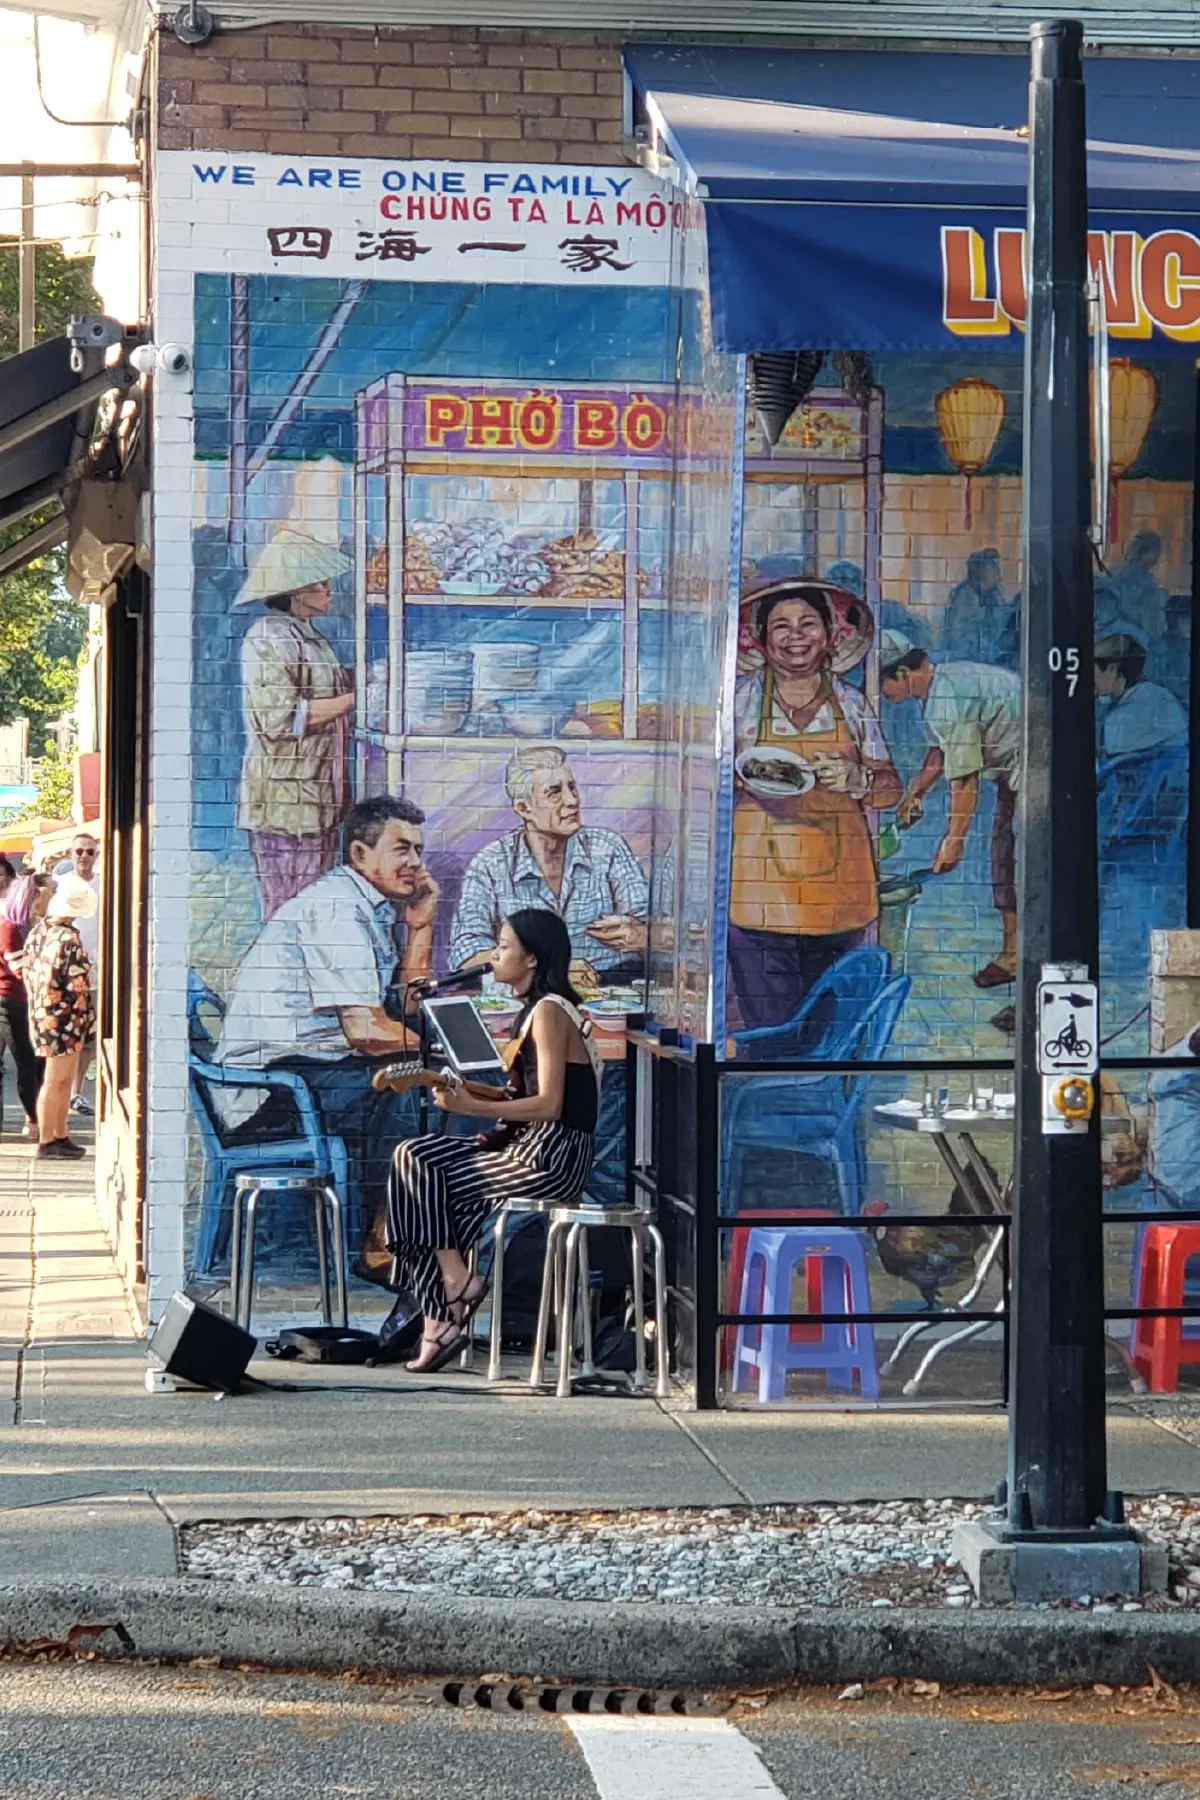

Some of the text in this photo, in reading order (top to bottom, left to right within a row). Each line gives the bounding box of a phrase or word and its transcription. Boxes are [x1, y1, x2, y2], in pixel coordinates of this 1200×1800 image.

[192, 164, 633, 197] WE ARE ONE FAMILY
[379, 191, 674, 234] CHÚNG TA LÀ MỘ
[424, 388, 666, 451] PHỞ BÒ
[1048, 646, 1080, 672] 05
[1065, 674, 1079, 698] 7
